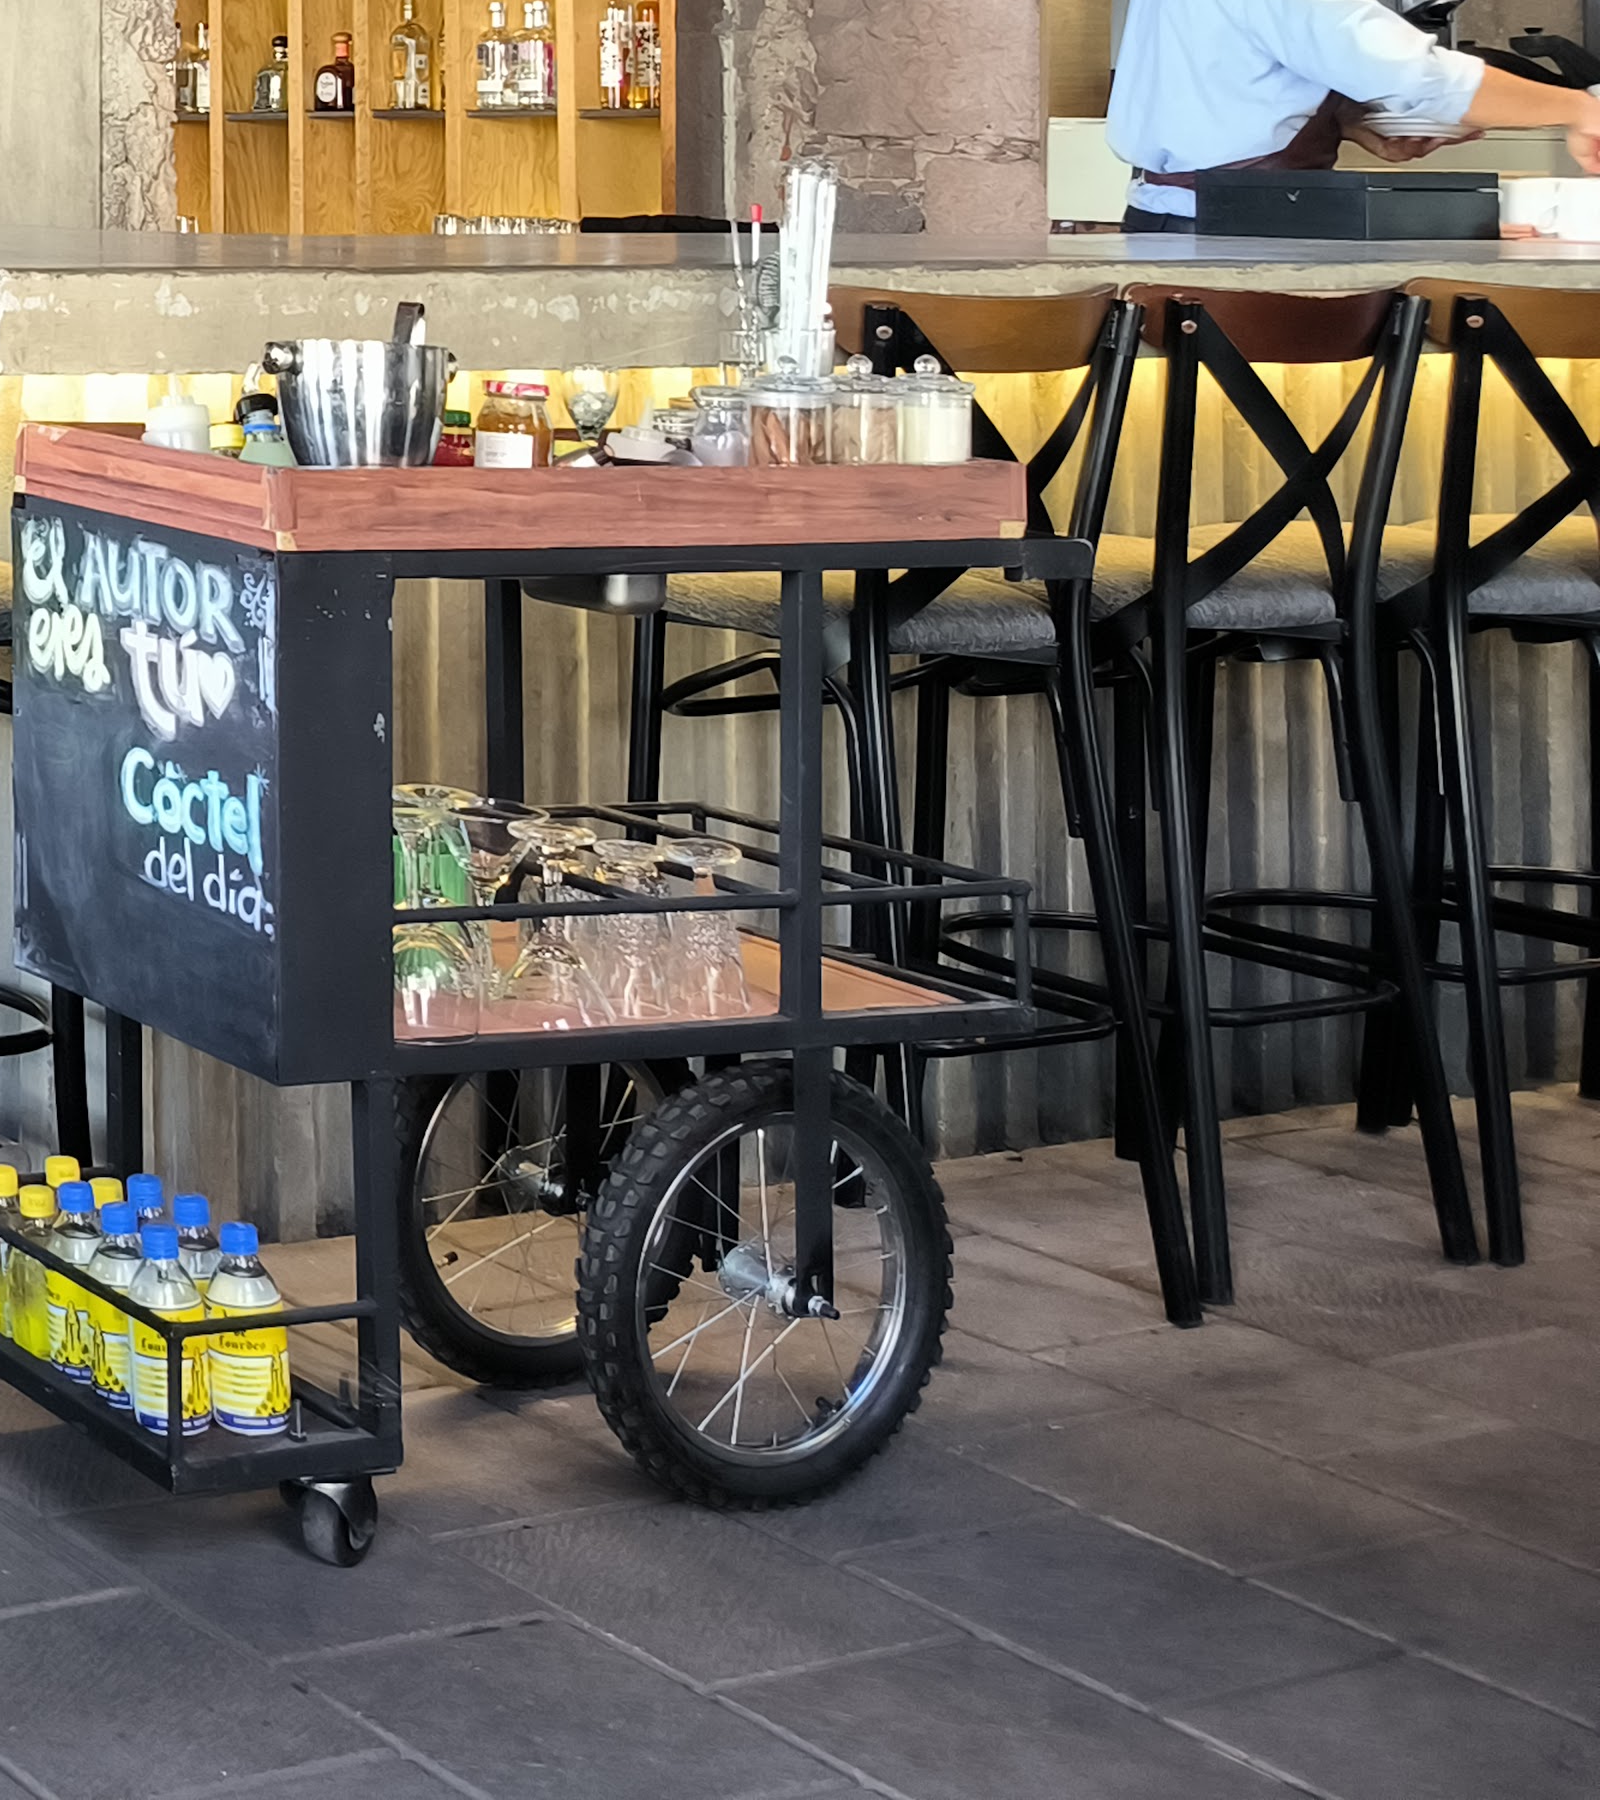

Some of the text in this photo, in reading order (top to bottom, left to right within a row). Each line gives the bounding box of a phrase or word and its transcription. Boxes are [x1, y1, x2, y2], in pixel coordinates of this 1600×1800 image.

[76, 533, 246, 654] AUTOR
[121, 746, 264, 877] Cóctel
[143, 835, 195, 901] del
